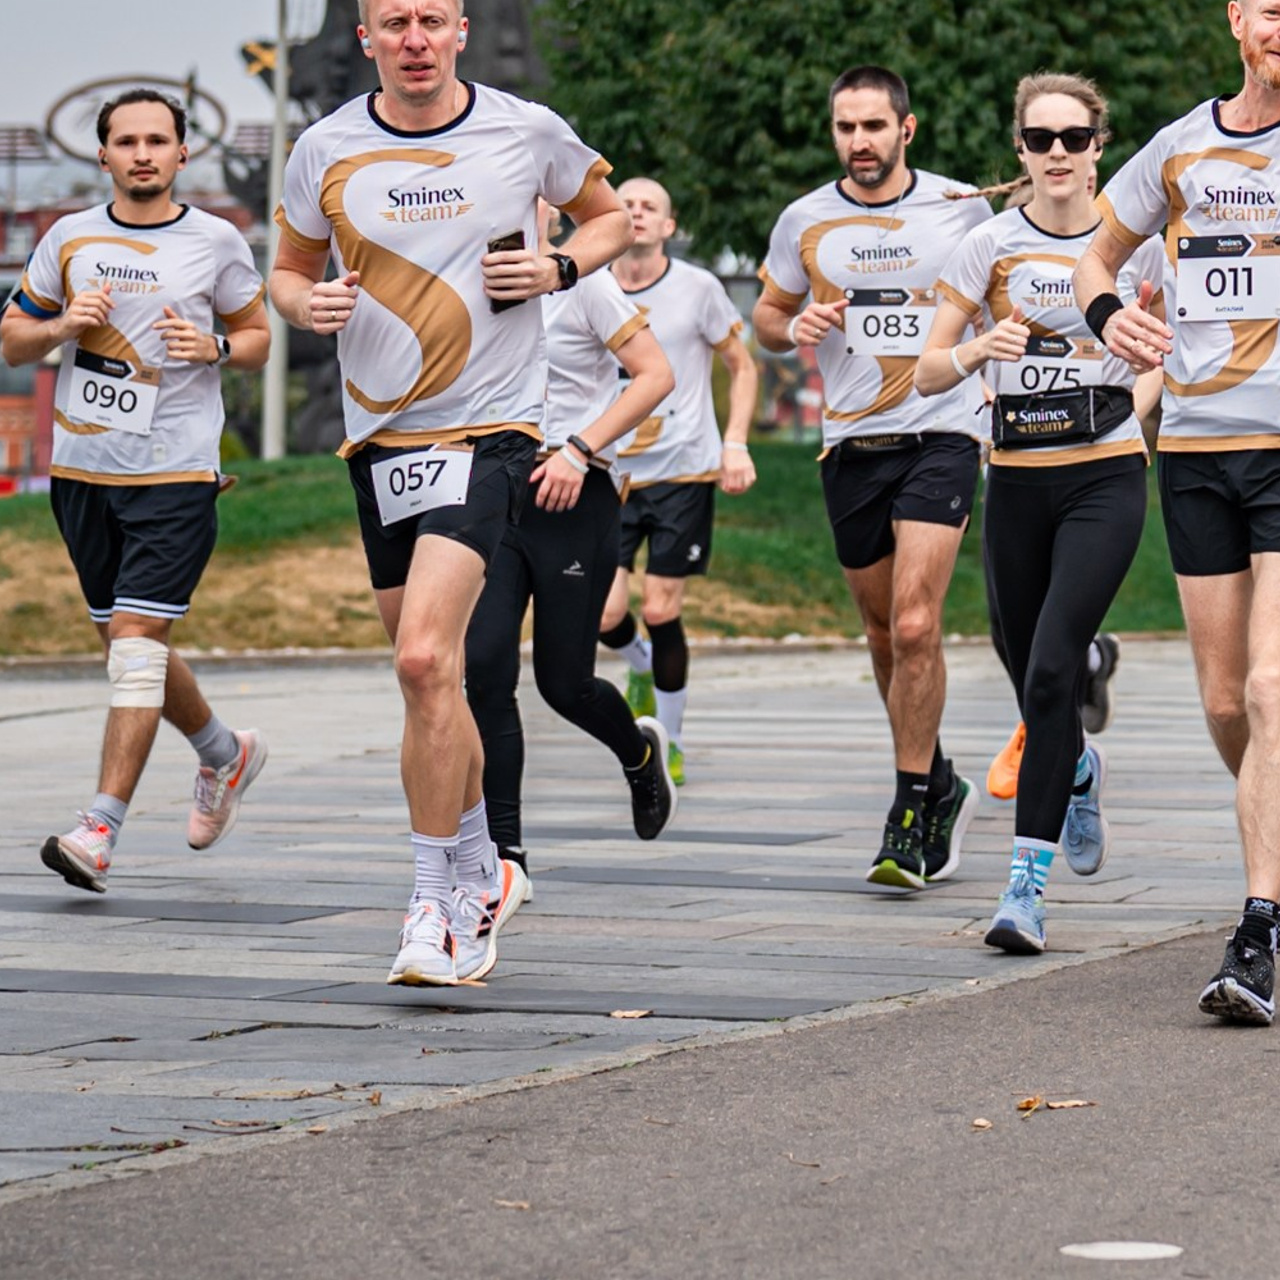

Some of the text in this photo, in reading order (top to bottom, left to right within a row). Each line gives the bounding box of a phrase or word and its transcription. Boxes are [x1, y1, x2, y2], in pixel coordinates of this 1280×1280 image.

[388, 186, 465, 208] Sminex
[1204, 185, 1275, 205] Sminex
[400, 204, 453, 223] team
[1215, 205, 1265, 222] team
[851, 245, 913, 261] Sminex
[95, 261, 160, 282] Sminex
[862, 260, 903, 274] team
[1205, 267, 1253, 297] 011
[863, 314, 919, 338] 083
[1021, 365, 1081, 392] 075
[83, 380, 138, 413] 090
[1019, 408, 1069, 424] Sminex
[1028, 421, 1063, 434] team
[389, 459, 448, 497] 057
